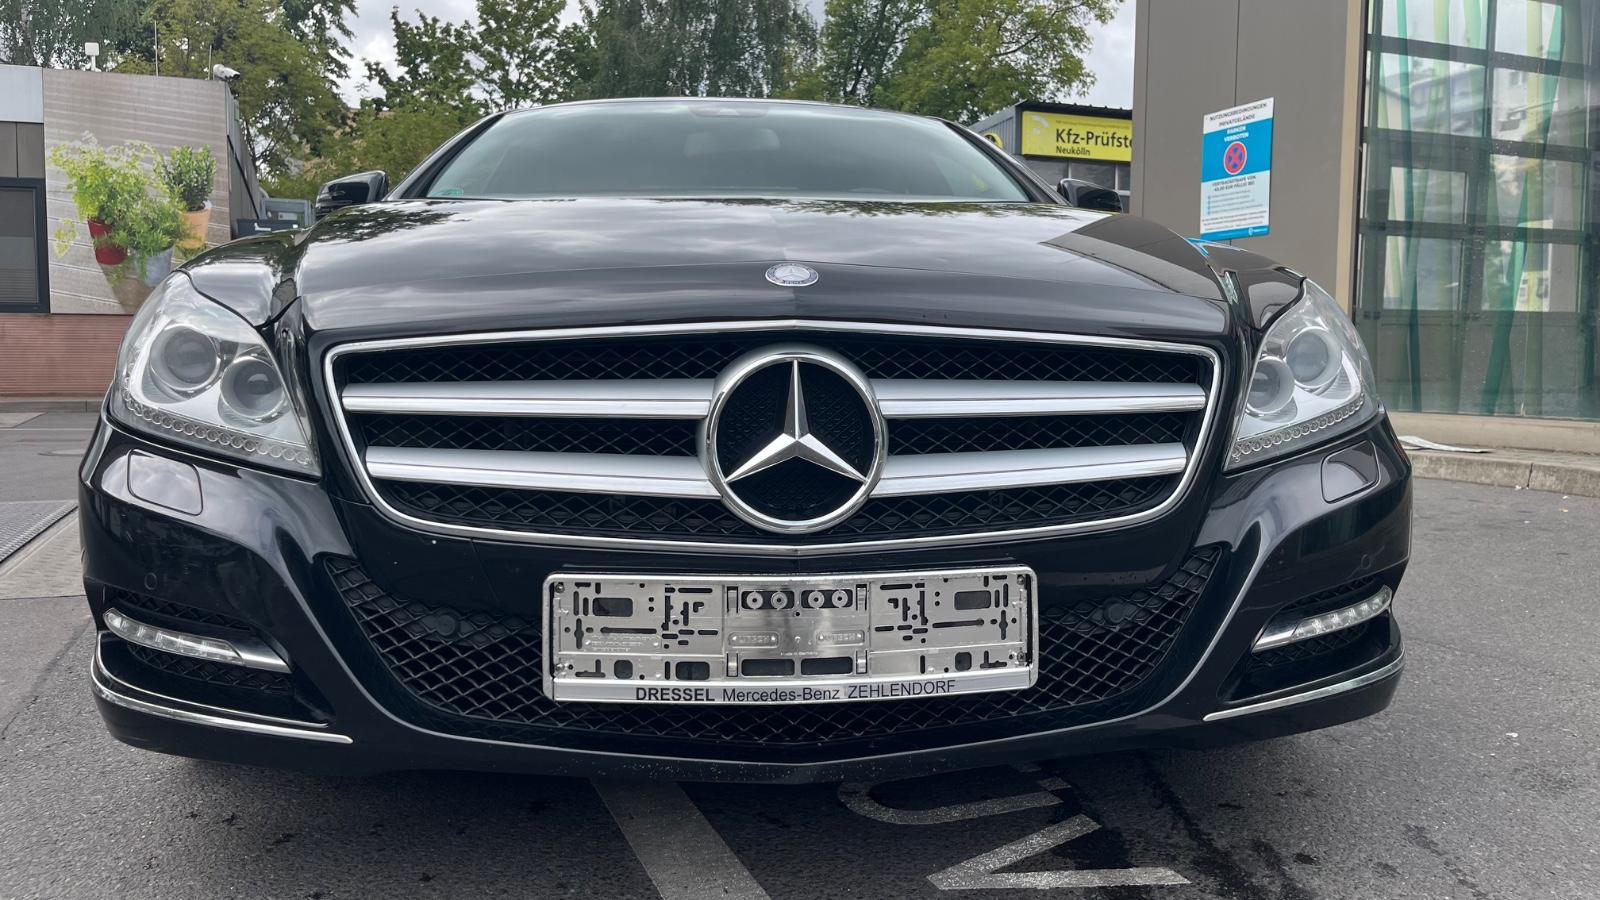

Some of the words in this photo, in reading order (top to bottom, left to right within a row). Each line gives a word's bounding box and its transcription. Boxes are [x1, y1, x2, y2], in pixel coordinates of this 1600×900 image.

[1055, 145, 1091, 156] Neukölln
[635, 687, 716, 702] DRESSEL
[722, 687, 841, 702] Mercedes-Benz
[847, 679, 957, 699] ZEHLENDORF
